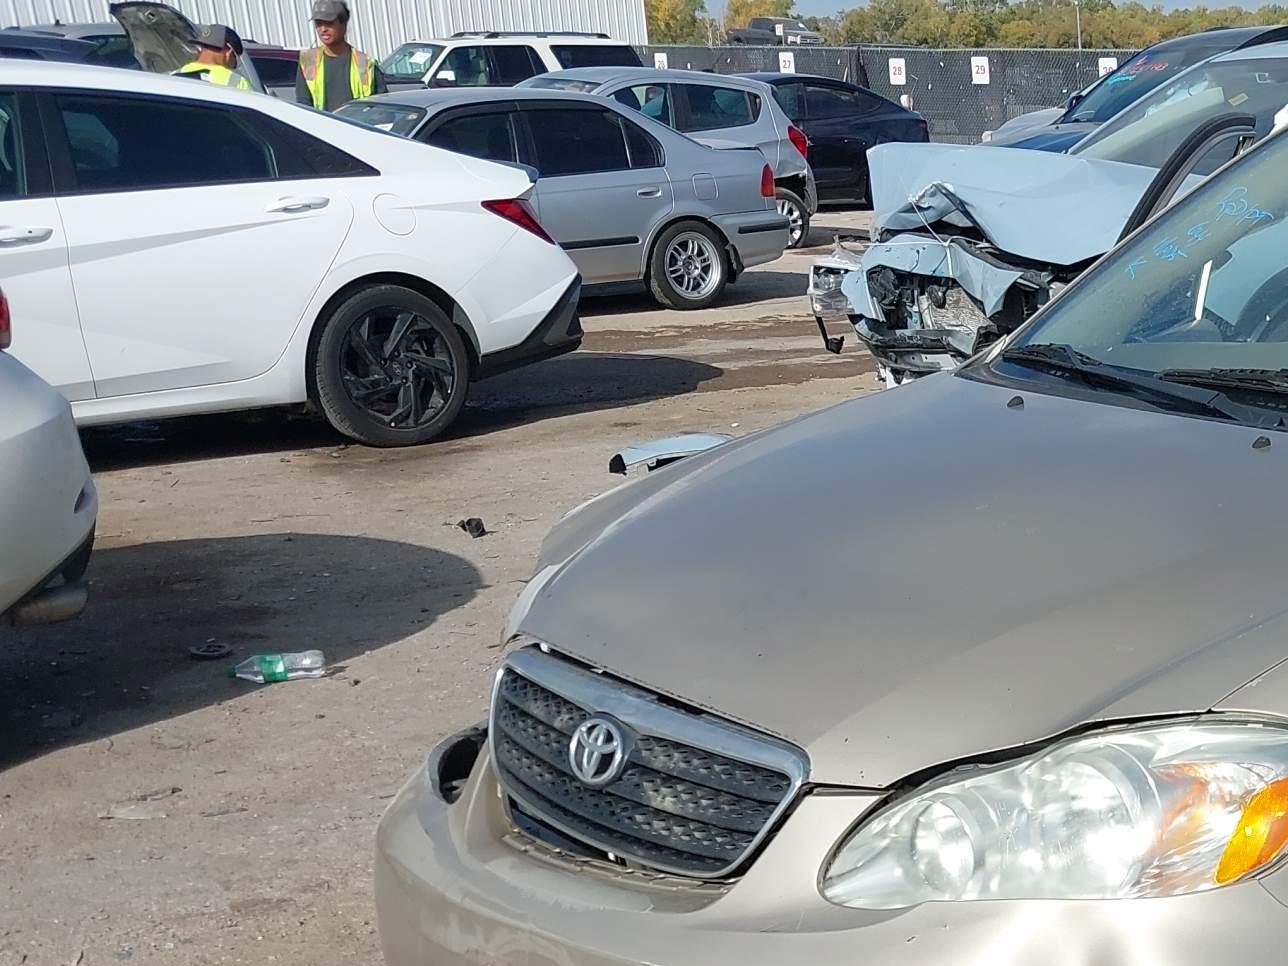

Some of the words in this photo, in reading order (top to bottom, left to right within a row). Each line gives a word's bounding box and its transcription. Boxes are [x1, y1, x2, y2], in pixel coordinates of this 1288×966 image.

[782, 59, 791, 69] 27
[892, 66, 903, 75] 28
[975, 65, 986, 75] 29
